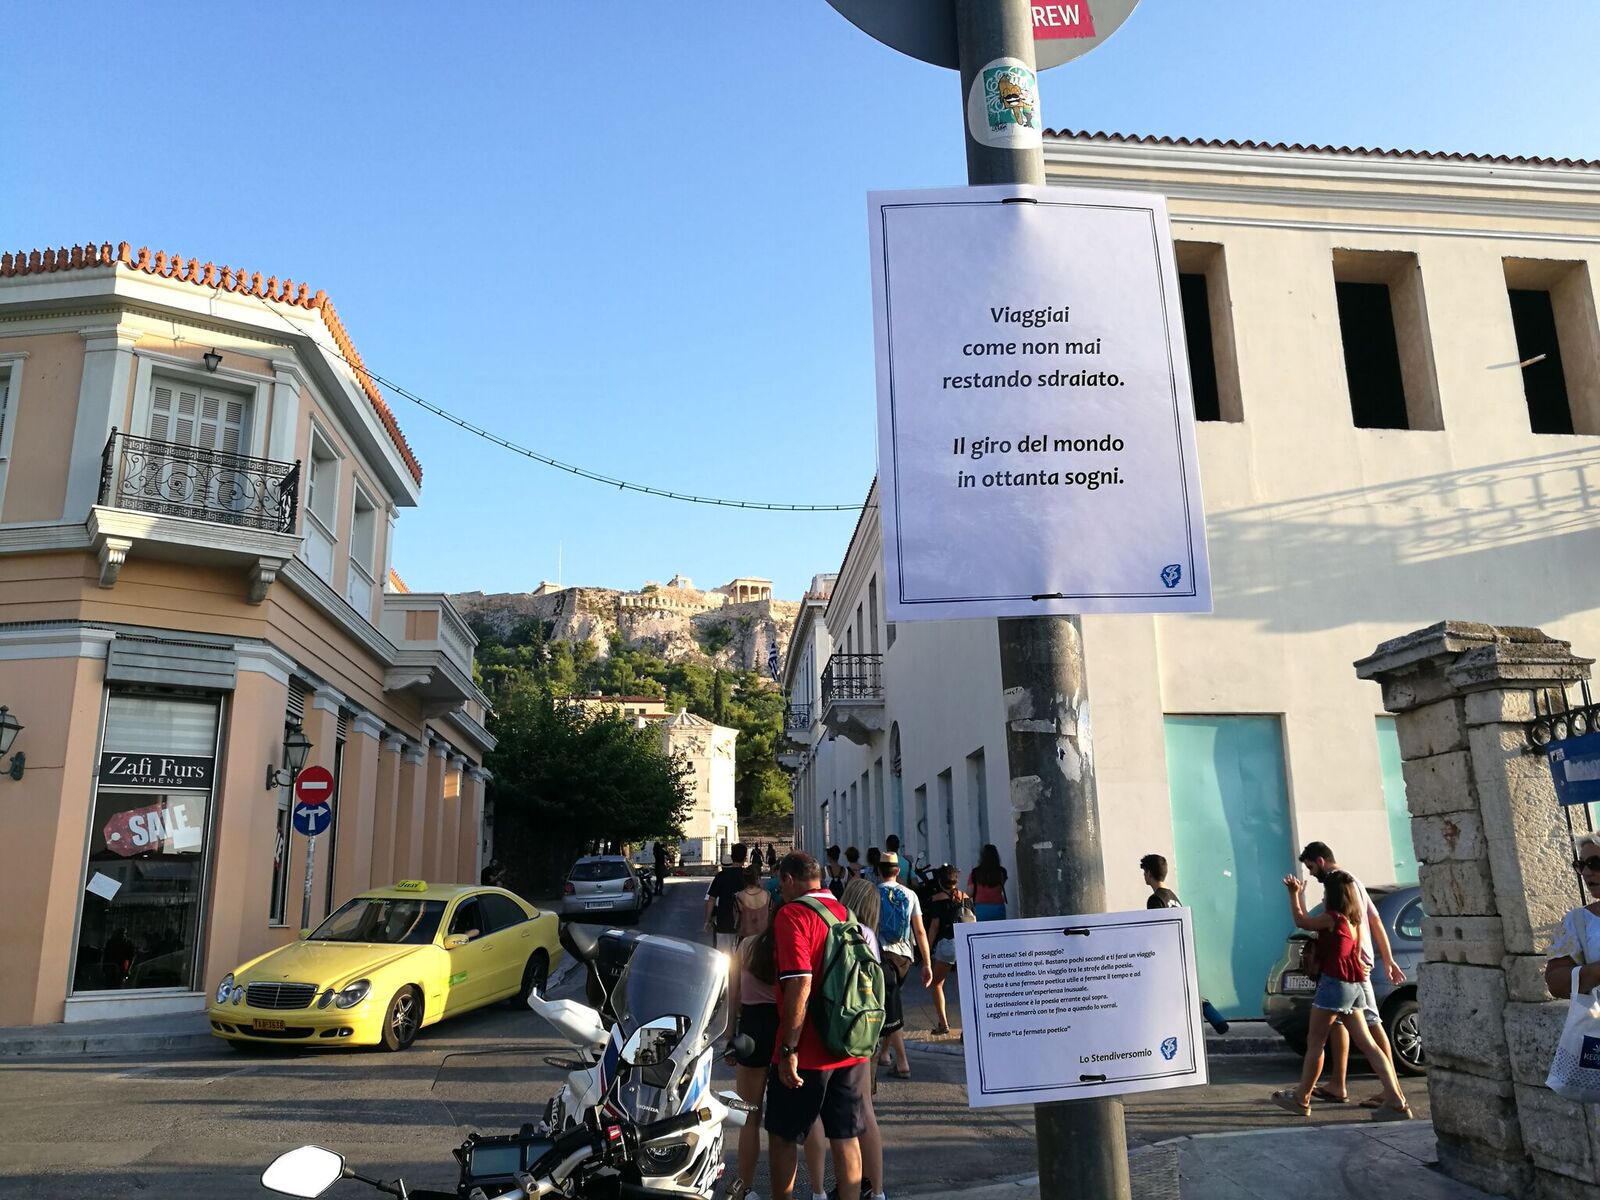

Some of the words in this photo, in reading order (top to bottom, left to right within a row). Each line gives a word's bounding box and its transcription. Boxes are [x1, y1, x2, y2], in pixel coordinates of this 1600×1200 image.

[1032, 4, 1080, 27] REW
[990, 306, 1070, 328] Viaggiai
[962, 342, 1017, 356] come
[1022, 341, 1059, 355] non
[1065, 338, 1101, 355] mai
[943, 370, 1032, 389] restando
[1037, 369, 1125, 388] sdraiato.
[953, 436, 965, 455] Il
[971, 436, 1012, 460] giro
[1017, 434, 1047, 453] del
[1053, 434, 1124, 452] mondo
[958, 470, 976, 488] in
[982, 469, 1059, 487] ottanta
[1064, 467, 1125, 490] sogni.
[108, 756, 152, 776] Zafi
[159, 758, 205, 778] Furs
[131, 776, 183, 785] ATHENS
[128, 804, 190, 846] SALE
[1034, 948, 1065, 957] passaggio?
[1069, 956, 1084, 965] pochi
[1085, 954, 1105, 962] secondi
[1115, 953, 1128, 961] farai
[1136, 950, 1156, 958] viaggio
[983, 972, 1006, 980] gratuito
[1047, 967, 1067, 975] viaggio
[1115, 963, 1134, 971] poesia.
[1084, 975, 1106, 983] fermare
[984, 991, 1024, 999] intraprendere
[1041, 997, 1059, 1005] poesia
[986, 1011, 1009, 1020] Leggimi
[1015, 1008, 1036, 1016] rimarrò
[1072, 1005, 1093, 1013] quando
[1023, 1028, 1046, 1037] fermata
[1079, 1055, 1090, 1064] Lo
[1091, 1048, 1153, 1063] Stendiversomio
